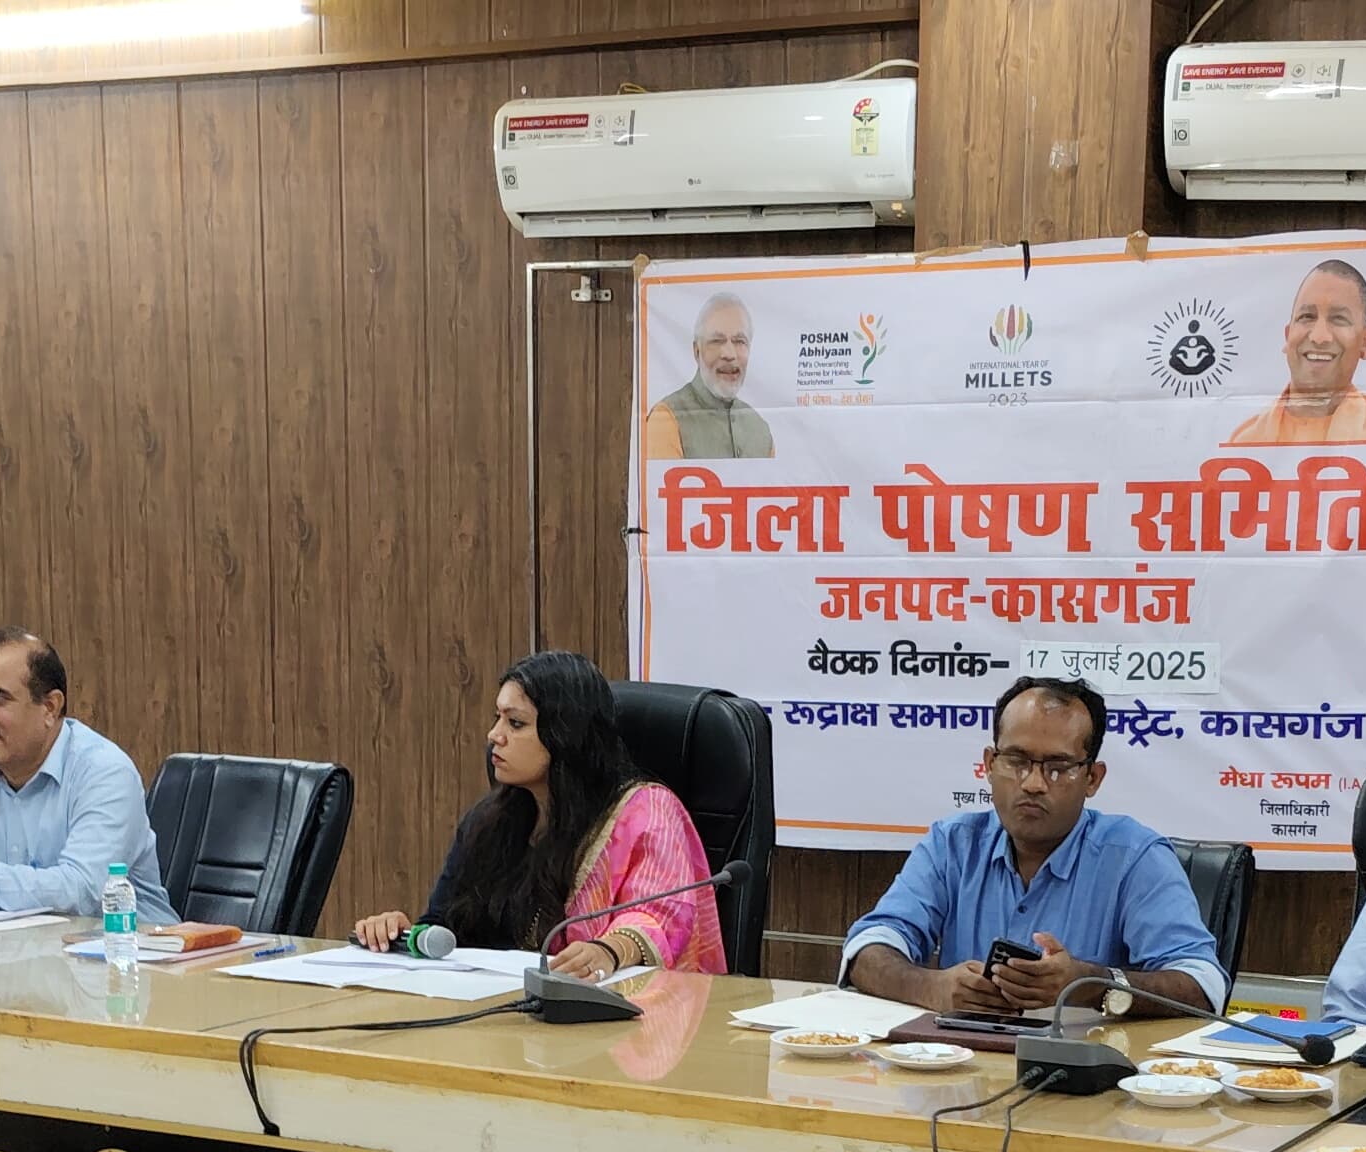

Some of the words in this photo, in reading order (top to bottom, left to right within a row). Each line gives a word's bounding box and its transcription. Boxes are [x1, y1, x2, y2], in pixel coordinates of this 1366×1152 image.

[1184, 67, 1201, 76] SAVE
[1201, 66, 1228, 76] ENERGY
[1229, 66, 1246, 75] SAVE
[1247, 65, 1283, 75] EVERYDAY
[800, 331, 849, 344] POSHAN
[798, 345, 852, 359] Abhiyaan
[969, 360, 1021, 370] INTERNATIONAL
[1022, 360, 1039, 369] YEAR
[1039, 360, 1050, 369] OF
[965, 370, 1053, 389] MILLETS
[987, 391, 1028, 408] 2023
[657, 465, 850, 554] जिला
[873, 462, 1099, 554] पोषण
[815, 562, 1196, 625] जनपद-कासगंज
[807, 638, 881, 677] बैठक
[1026, 650, 1049, 669] 17
[1060, 643, 1124, 678] जुलाई
[1125, 650, 1207, 681] 2025
[1219, 765, 1265, 789] मेधा
[1270, 771, 1333, 790] रूपम
[952, 791, 976, 808] मुख्य
[1259, 798, 1331, 818] जिलाधिकारी
[1271, 820, 1318, 837] कासगंज
